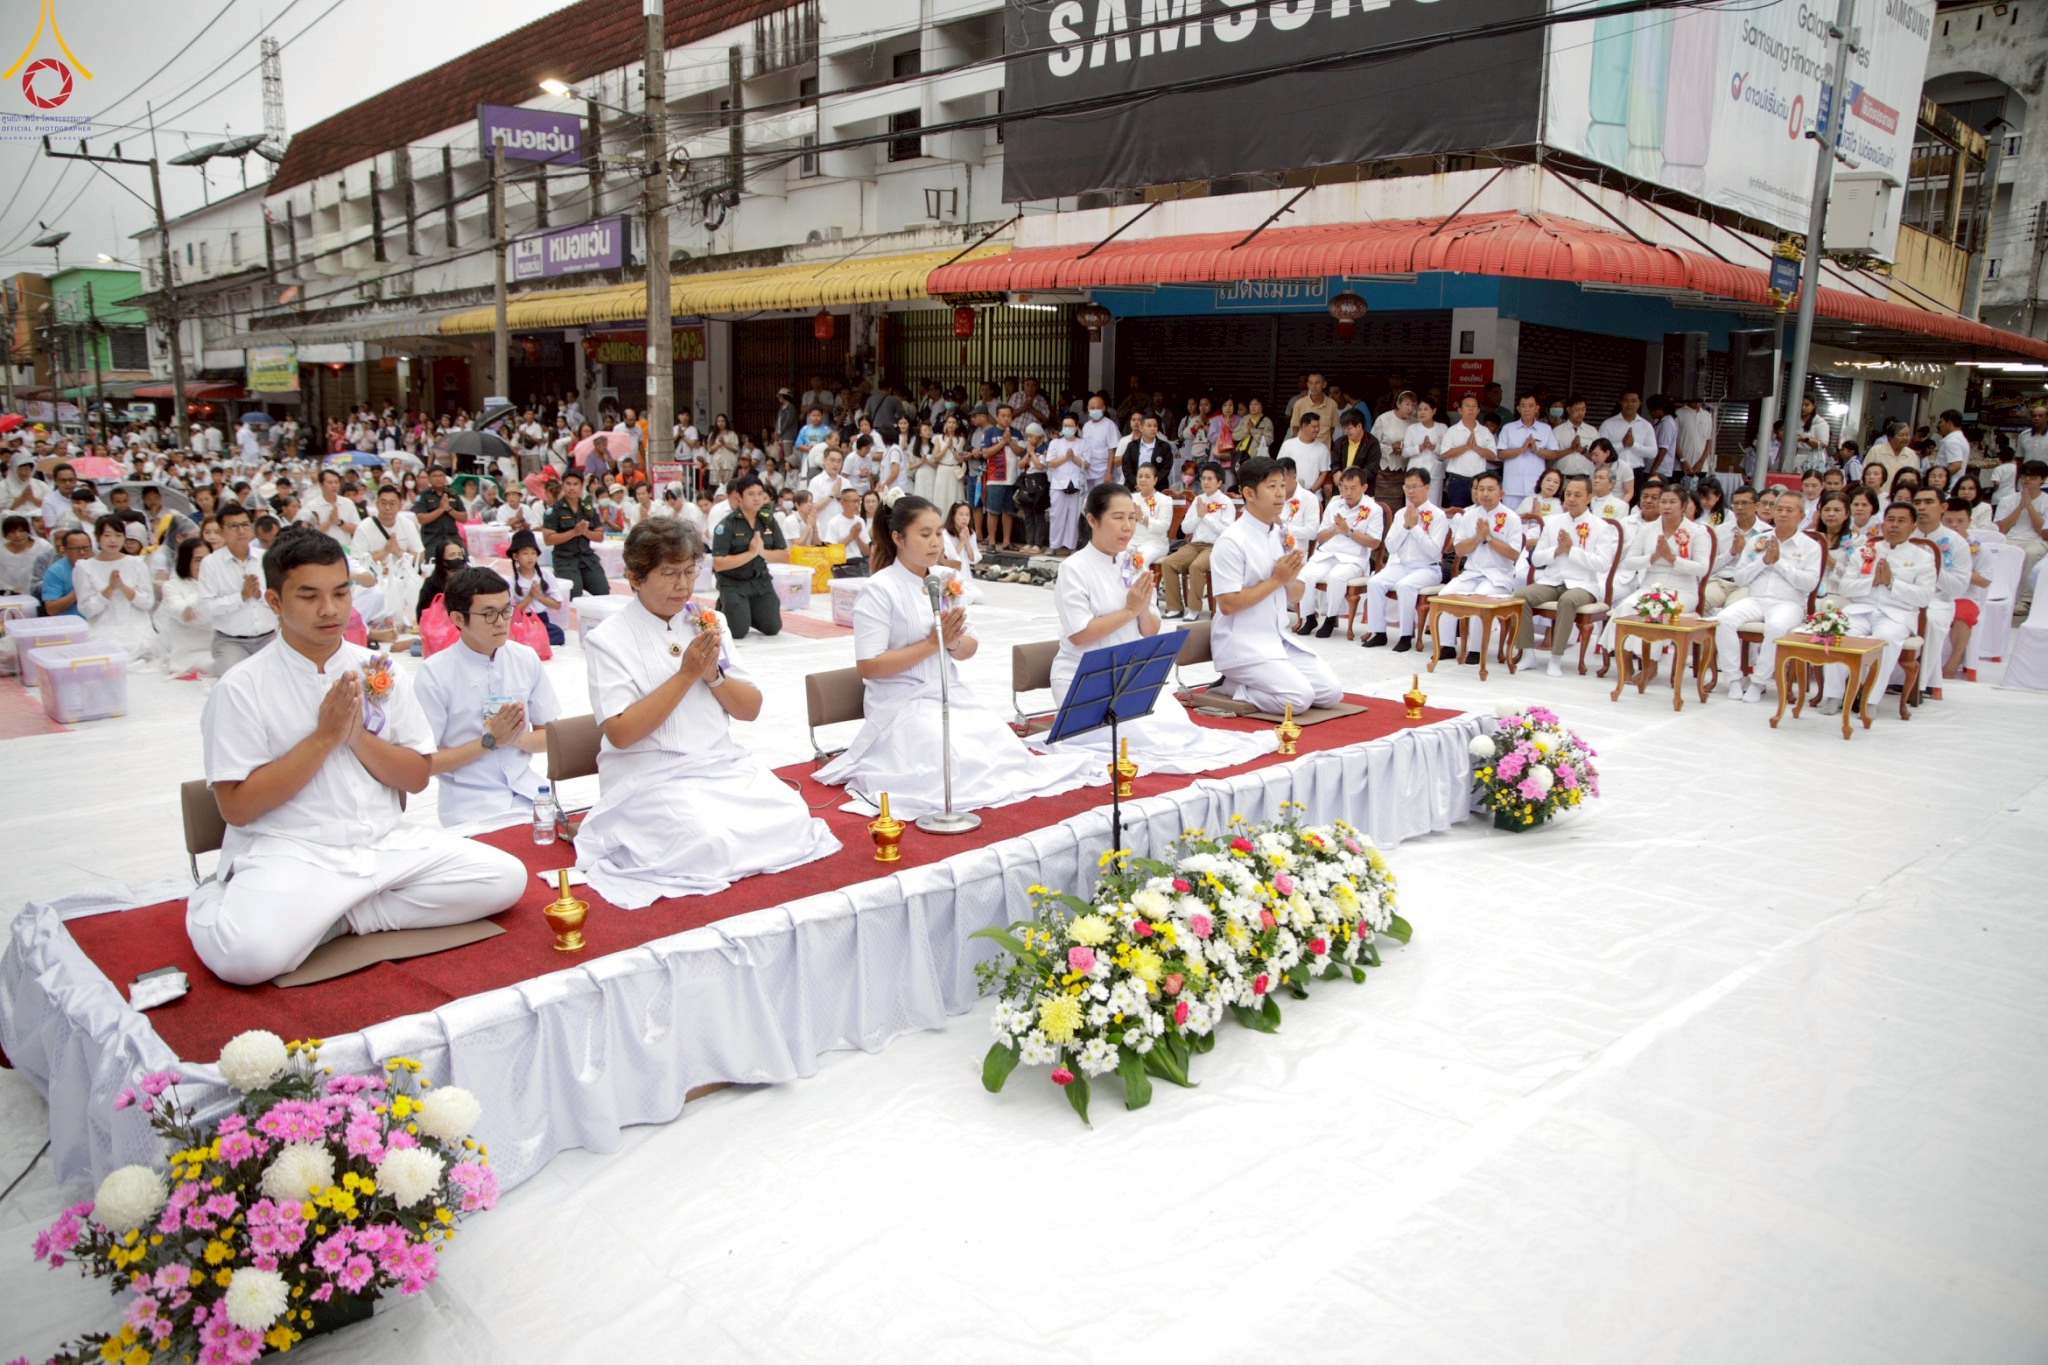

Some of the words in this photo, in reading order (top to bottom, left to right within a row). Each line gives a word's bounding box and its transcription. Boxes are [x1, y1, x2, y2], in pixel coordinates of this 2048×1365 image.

[1886, 0, 1930, 41] SAMSUNG
[1742, 19, 1790, 72] Samsung
[491, 126, 575, 153] หมอแว่น
[550, 222, 611, 263] หมอแว่น
